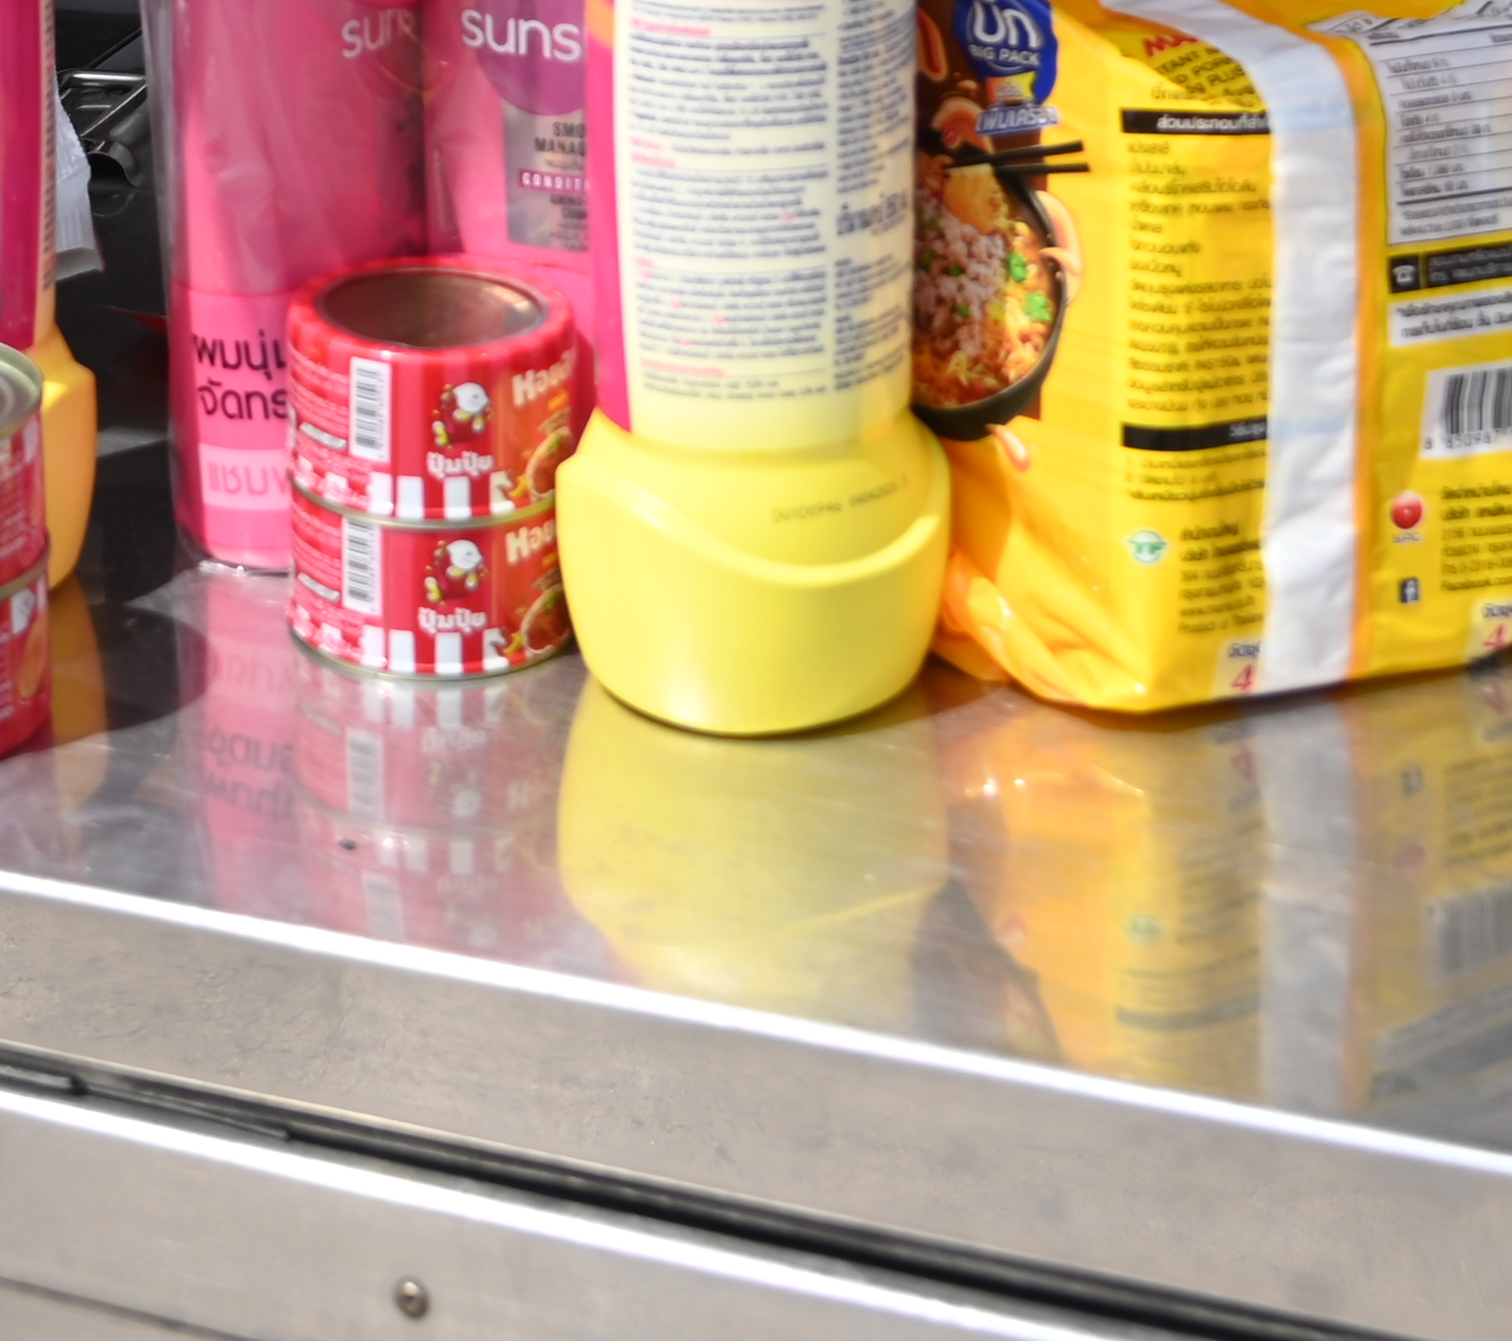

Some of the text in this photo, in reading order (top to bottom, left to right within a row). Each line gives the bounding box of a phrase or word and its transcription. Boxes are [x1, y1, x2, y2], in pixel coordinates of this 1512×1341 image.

[969, 45, 1040, 65] BIG PACK
[1483, 624, 1506, 651] 4
[1232, 663, 1256, 692] 4
